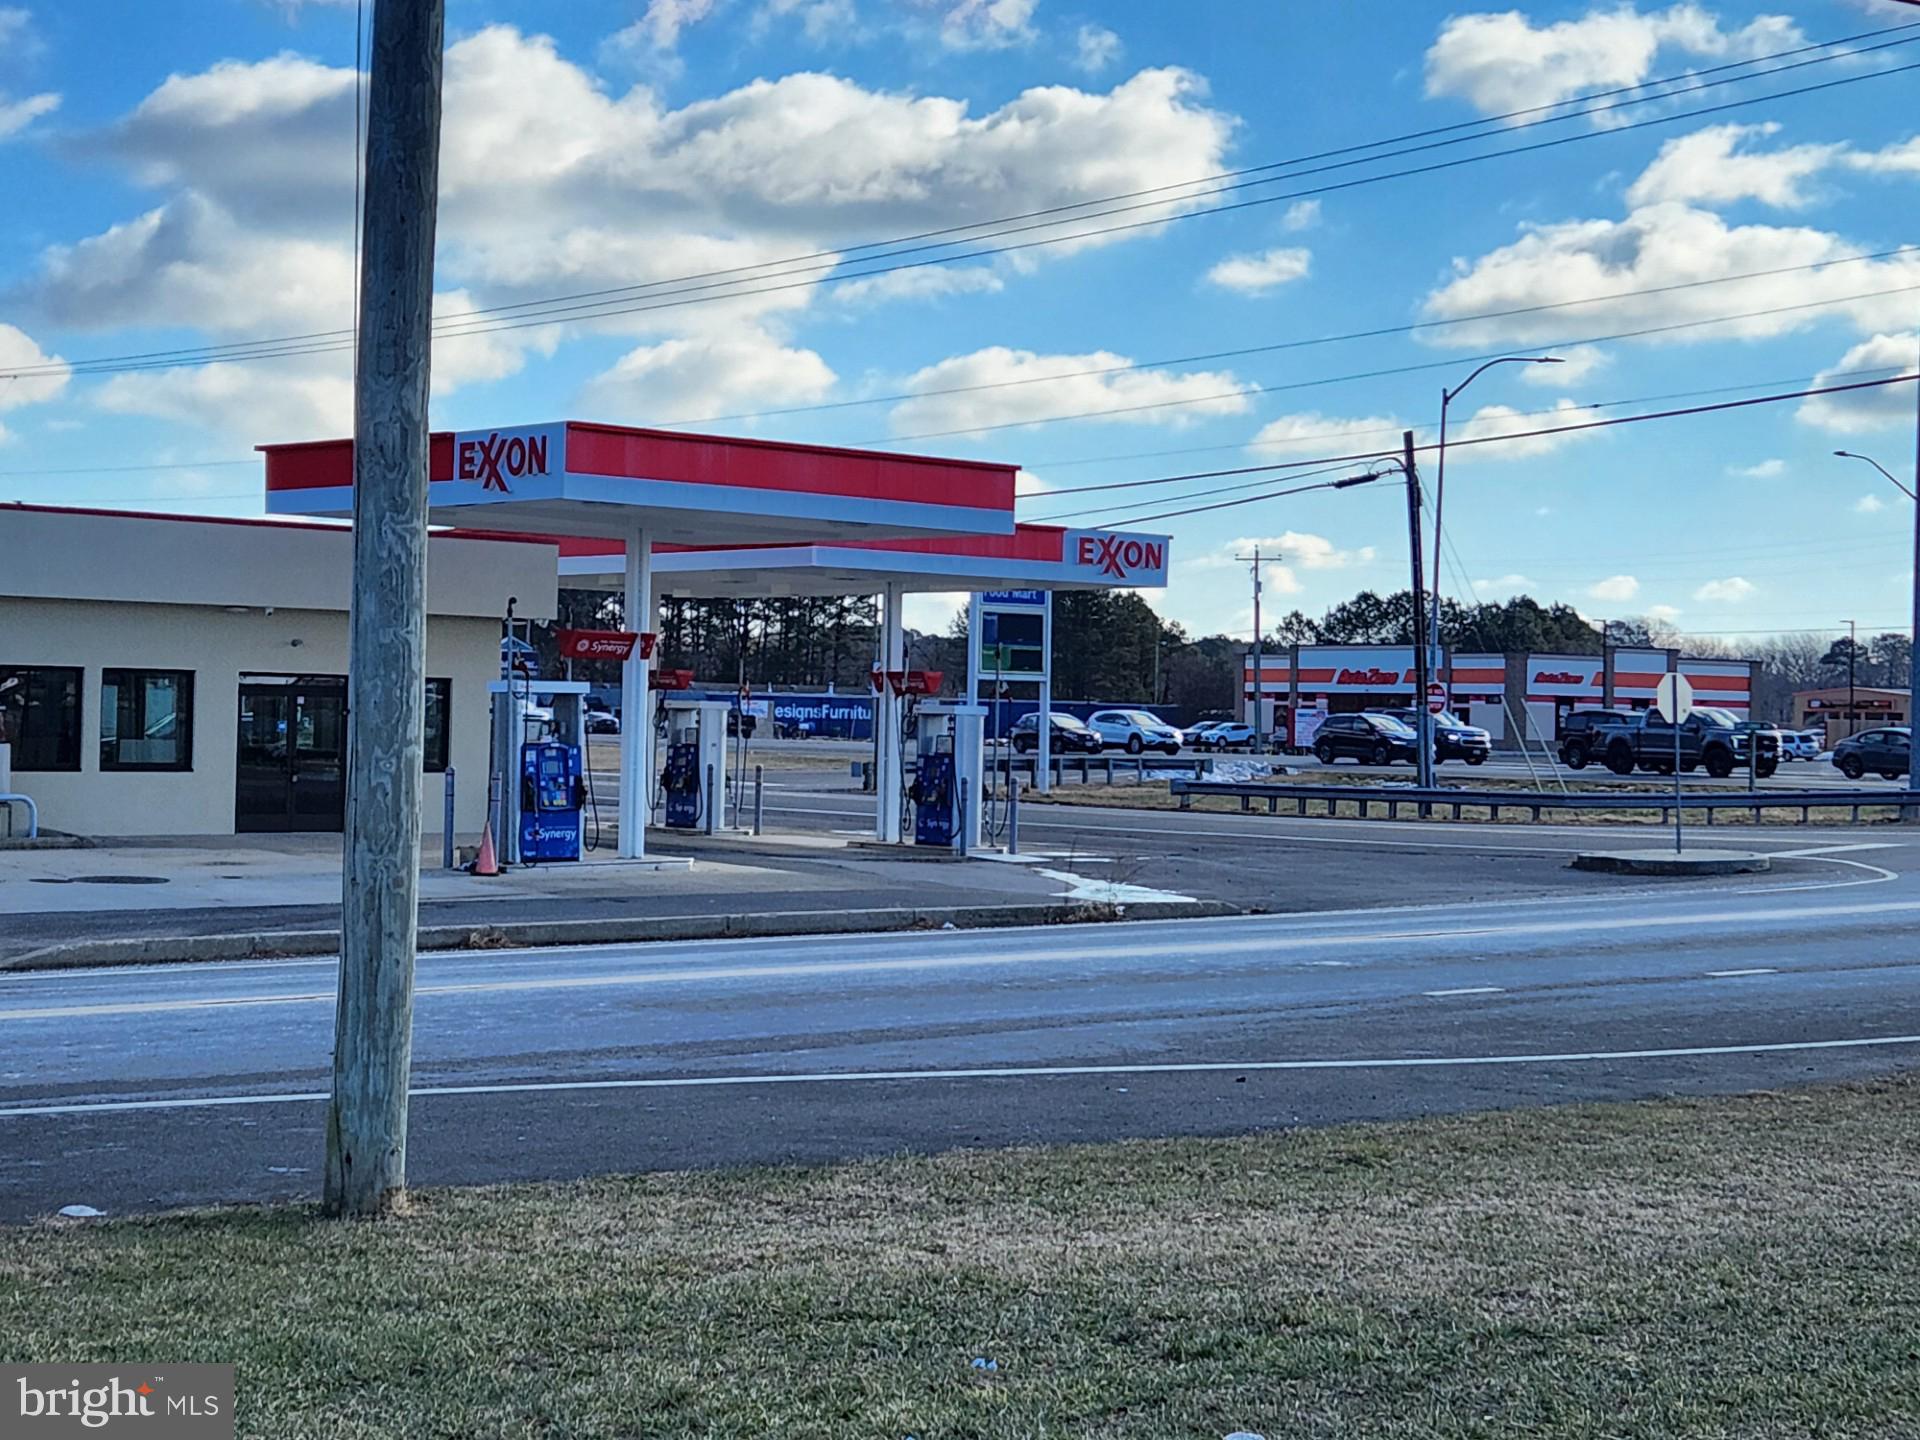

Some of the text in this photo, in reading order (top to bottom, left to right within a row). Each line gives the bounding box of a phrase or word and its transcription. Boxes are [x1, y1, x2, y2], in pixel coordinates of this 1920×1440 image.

[458, 432, 547, 492] EXXON
[1079, 534, 1162, 578] EXXON
[590, 641, 630, 655] Synergy
[539, 828, 577, 842] Synergy
